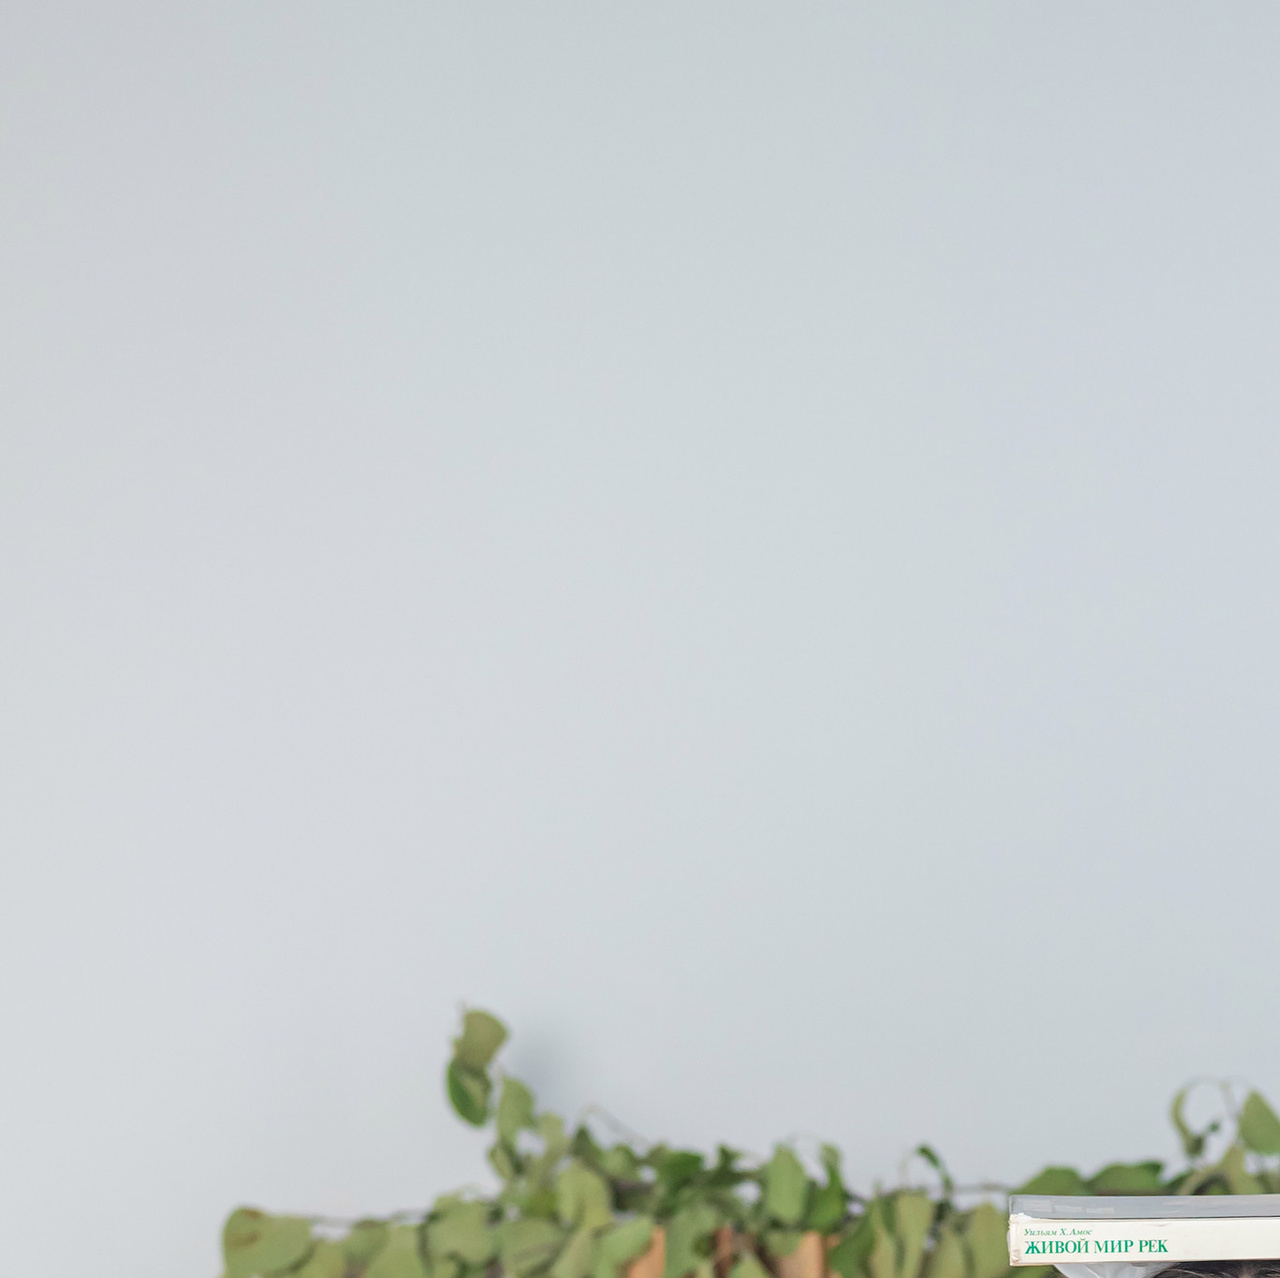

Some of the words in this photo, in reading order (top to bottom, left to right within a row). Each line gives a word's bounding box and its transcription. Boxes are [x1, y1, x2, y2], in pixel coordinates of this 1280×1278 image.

[1024, 1228, 1057, 1236] Уильям
[1024, 1238, 1089, 1254] ЖИВОЙ
[1094, 1239, 1133, 1253] МИР
[1139, 1239, 1168, 1253] РЕК
